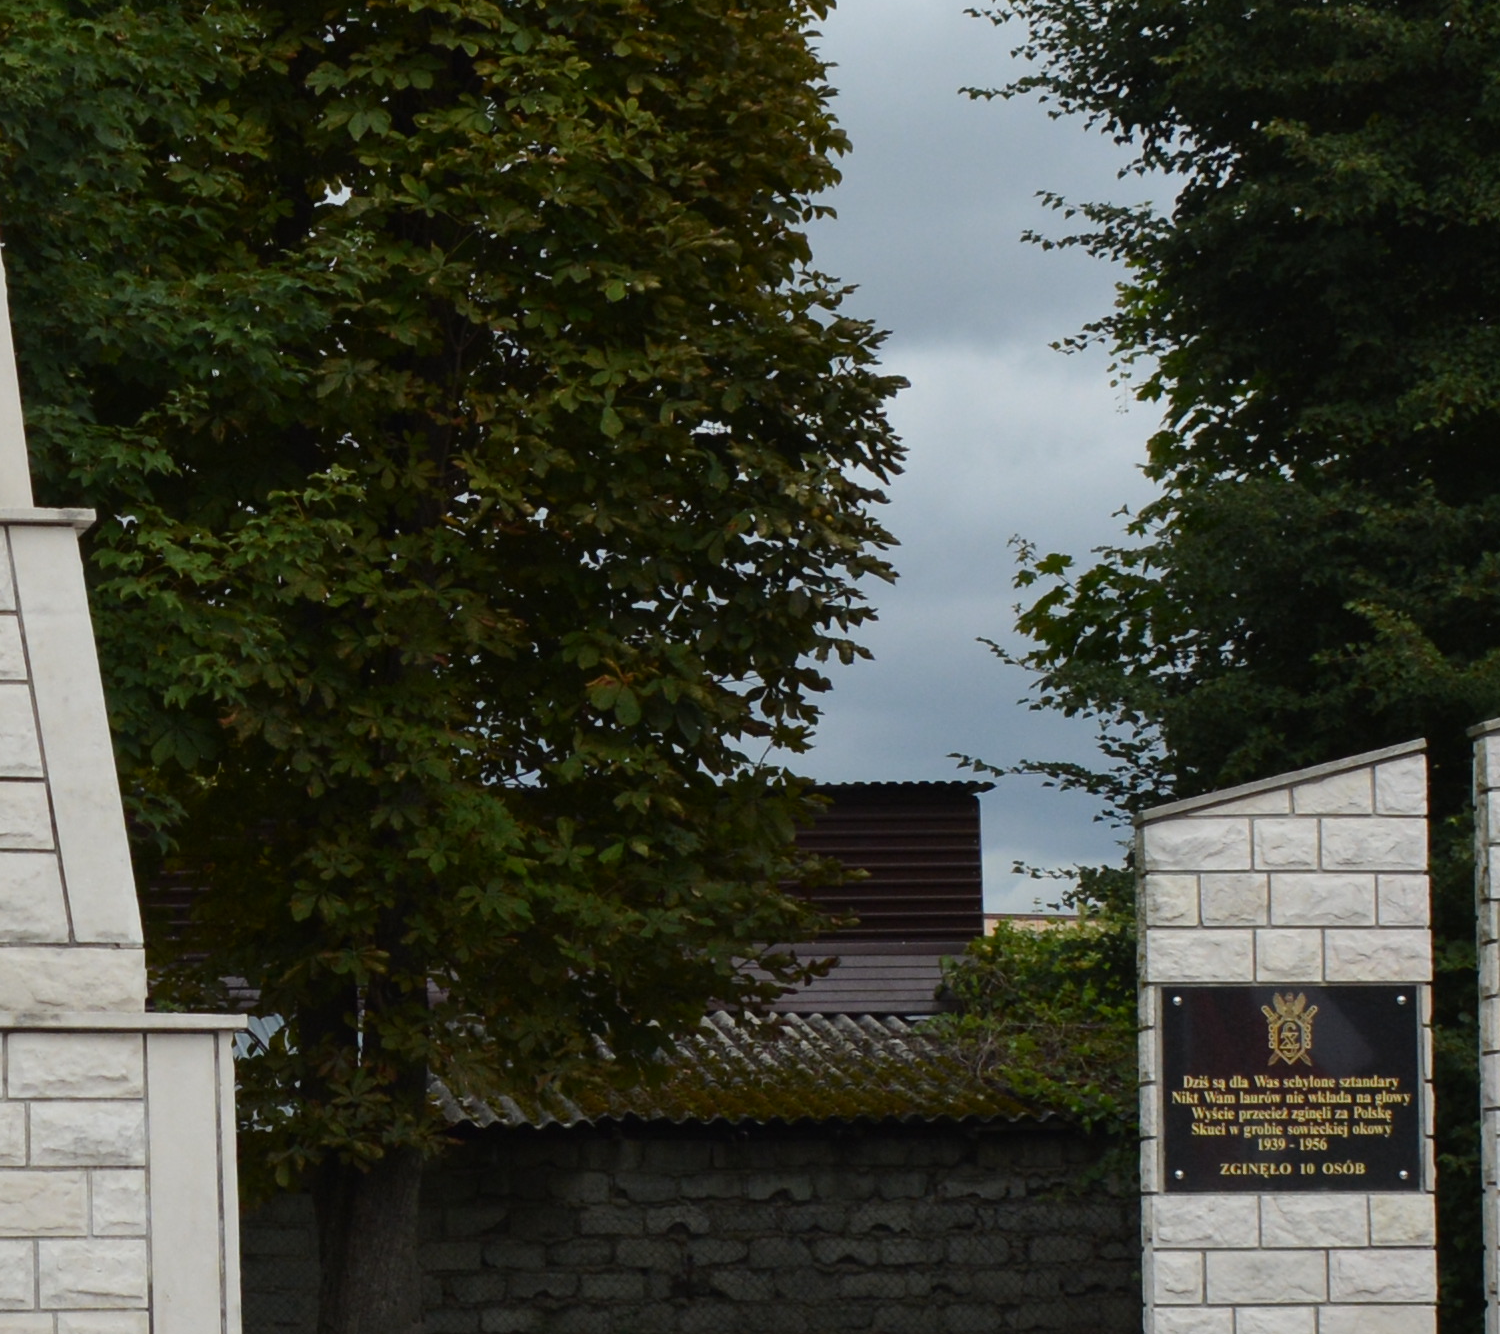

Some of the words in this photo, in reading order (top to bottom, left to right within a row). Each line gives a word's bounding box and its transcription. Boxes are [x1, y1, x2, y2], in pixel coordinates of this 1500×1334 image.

[1183, 1075, 1210, 1088] Dziś
[1212, 1078, 1226, 1092] są
[1229, 1075, 1249, 1088] dla
[1254, 1075, 1280, 1088] Was
[1339, 1074, 1399, 1091] sztandary
[1171, 1091, 1199, 1104] Nikt
[1204, 1091, 1236, 1104] Wam
[1239, 1090, 1282, 1104] laurów
[1285, 1090, 1305, 1104] nie
[1308, 1090, 1352, 1104] wkłada
[1356, 1093, 1372, 1104] na
[1375, 1090, 1412, 1107] głowy
[1191, 1107, 1236, 1123] Wyście
[1239, 1106, 1289, 1123] przecież
[1291, 1106, 1332, 1123] zginęli
[1334, 1109, 1349, 1119] za
[1353, 1106, 1393, 1123] Polskę
[1191, 1122, 1226, 1135] Skuci
[1229, 1125, 1240, 1135] w
[1243, 1122, 1284, 1139] grobie
[1287, 1122, 1348, 1138] sowieckiej
[1352, 1122, 1392, 1138] okowy
[1258, 1137, 1287, 1151] 1939
[1299, 1137, 1328, 1151] 1956
[1219, 1162, 1292, 1179] ZGINĘŁO
[1300, 1162, 1316, 1175] 10
[1321, 1159, 1366, 1175] OSÓB
